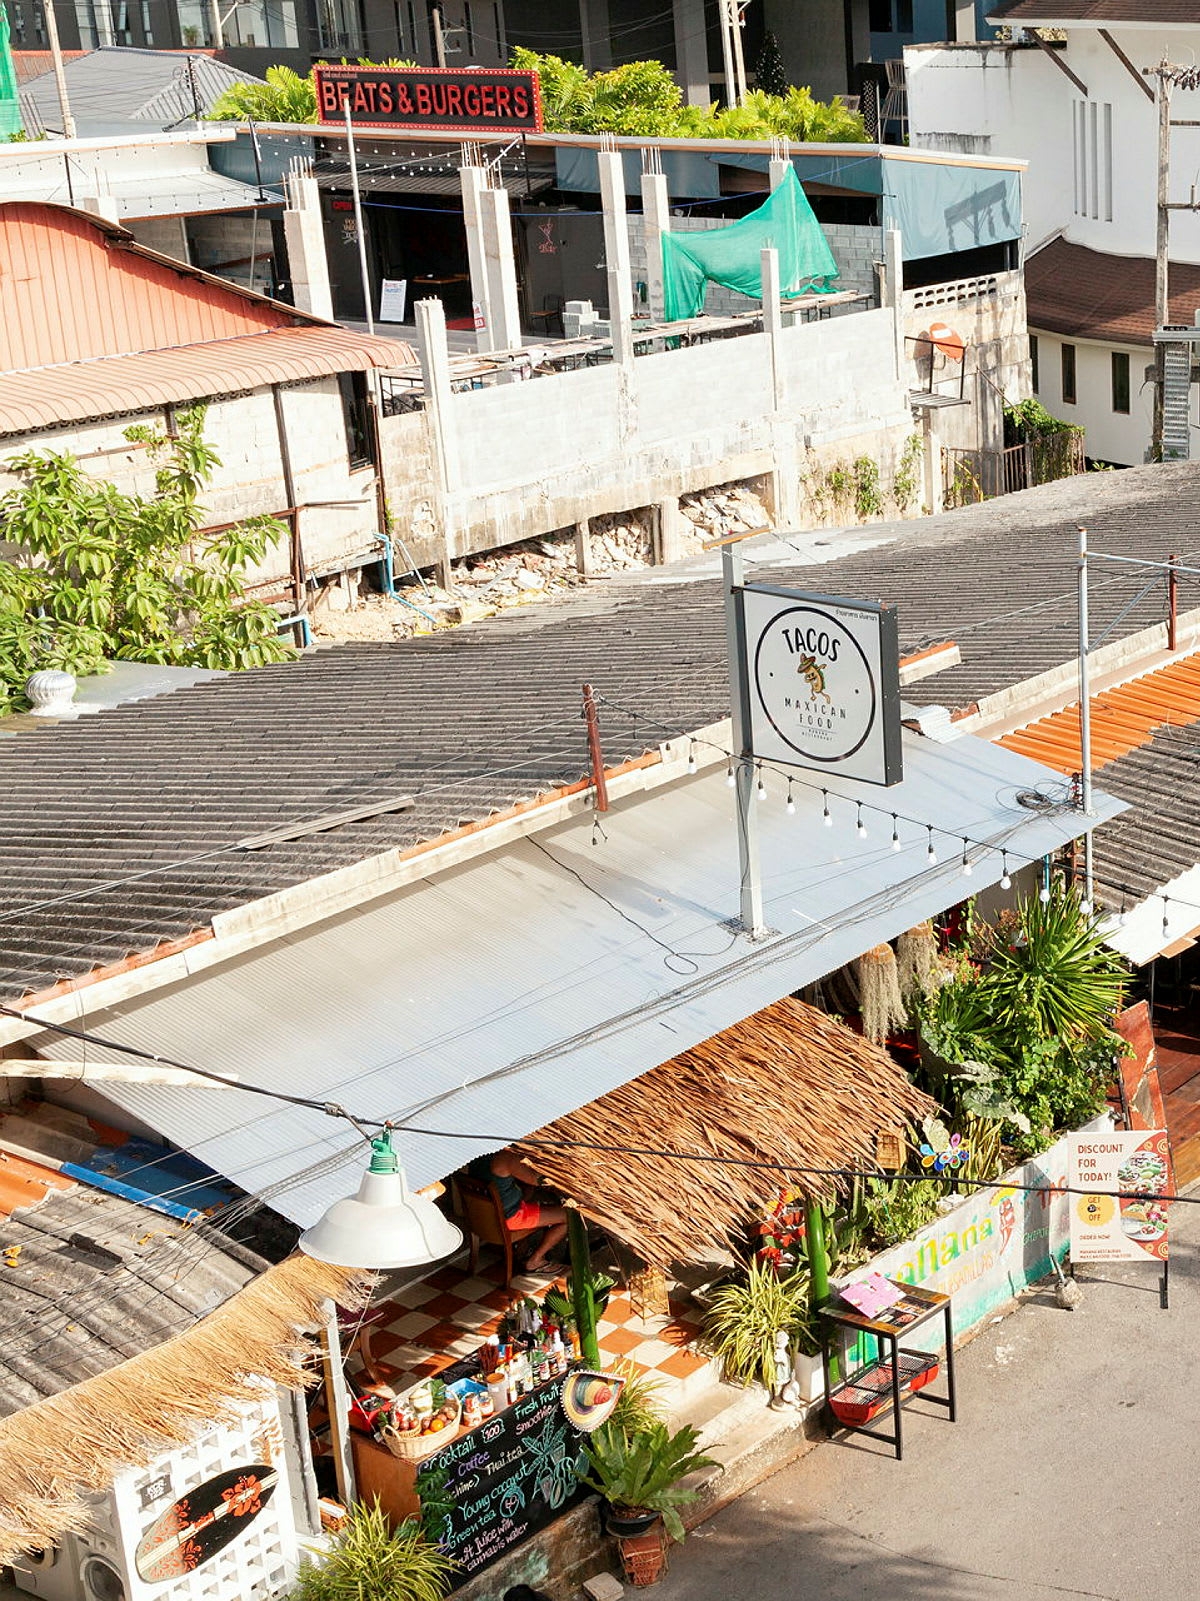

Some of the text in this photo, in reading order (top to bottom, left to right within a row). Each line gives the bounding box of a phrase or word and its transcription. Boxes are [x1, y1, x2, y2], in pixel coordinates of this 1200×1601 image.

[322, 81, 529, 119] BEATS & BURGERS
[782, 627, 841, 662] TACOS
[784, 697, 846, 719] MAXICAN
[800, 713, 833, 729] FOOD
[1077, 1144, 1124, 1154] DISCOUNT
[1077, 1159, 1097, 1168] FOR
[1078, 1172, 1112, 1182] TODAY!
[1088, 1196, 1101, 1204] GET
[515, 1382, 560, 1419] Fresh Fruit
[485, 1424, 500, 1440] 100
[458, 1451, 490, 1477] Coffee
[458, 1494, 491, 1521] Young
[448, 1522, 478, 1549] Green
[478, 1509, 496, 1526] tea
[467, 1522, 528, 1571] cannabis water
